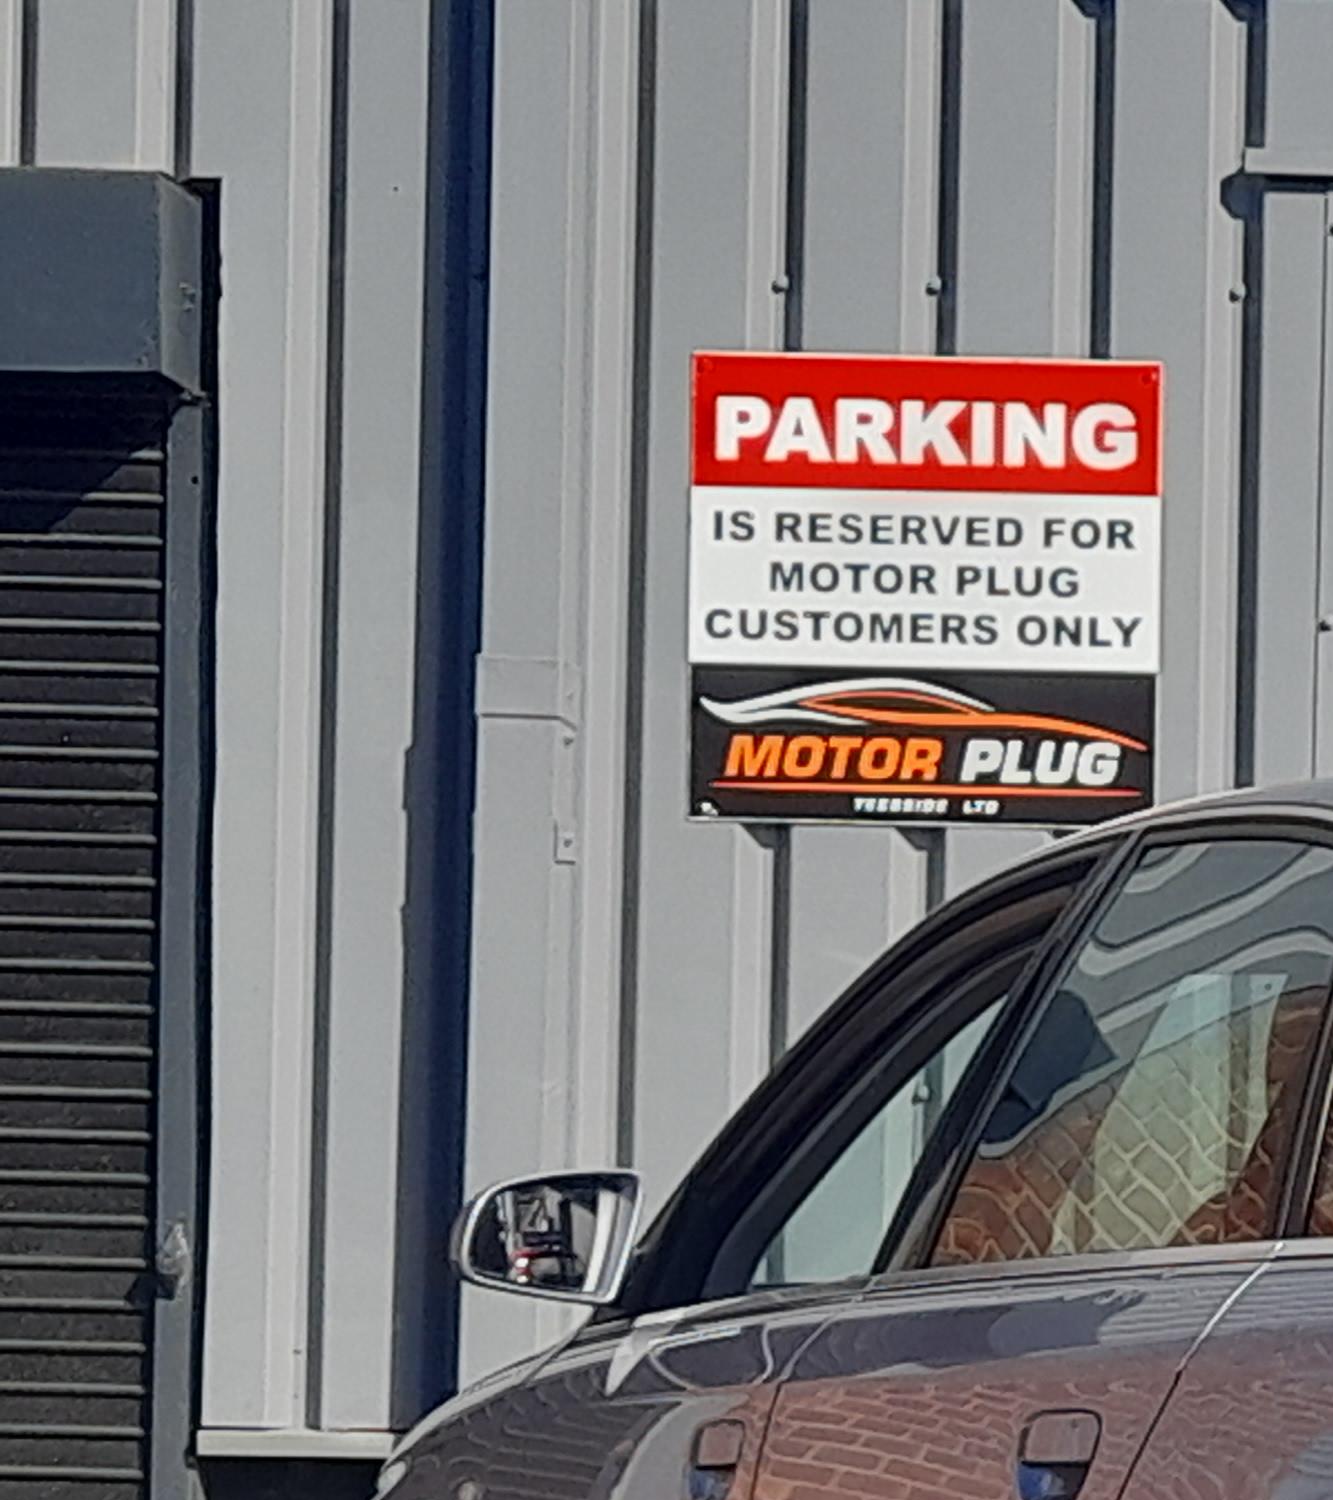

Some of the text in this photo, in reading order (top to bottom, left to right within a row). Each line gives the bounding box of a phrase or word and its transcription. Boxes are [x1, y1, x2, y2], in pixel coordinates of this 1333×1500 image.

[715, 395, 1139, 471] PARKING
[713, 511, 1136, 549] IS RESERVED FOR
[769, 562, 1080, 597] MOTOR PLUG
[705, 608, 1142, 648] CUSTOMERS ONLY
[723, 733, 1121, 786] MOTOR PLUG
[962, 799, 1000, 815] LTD
